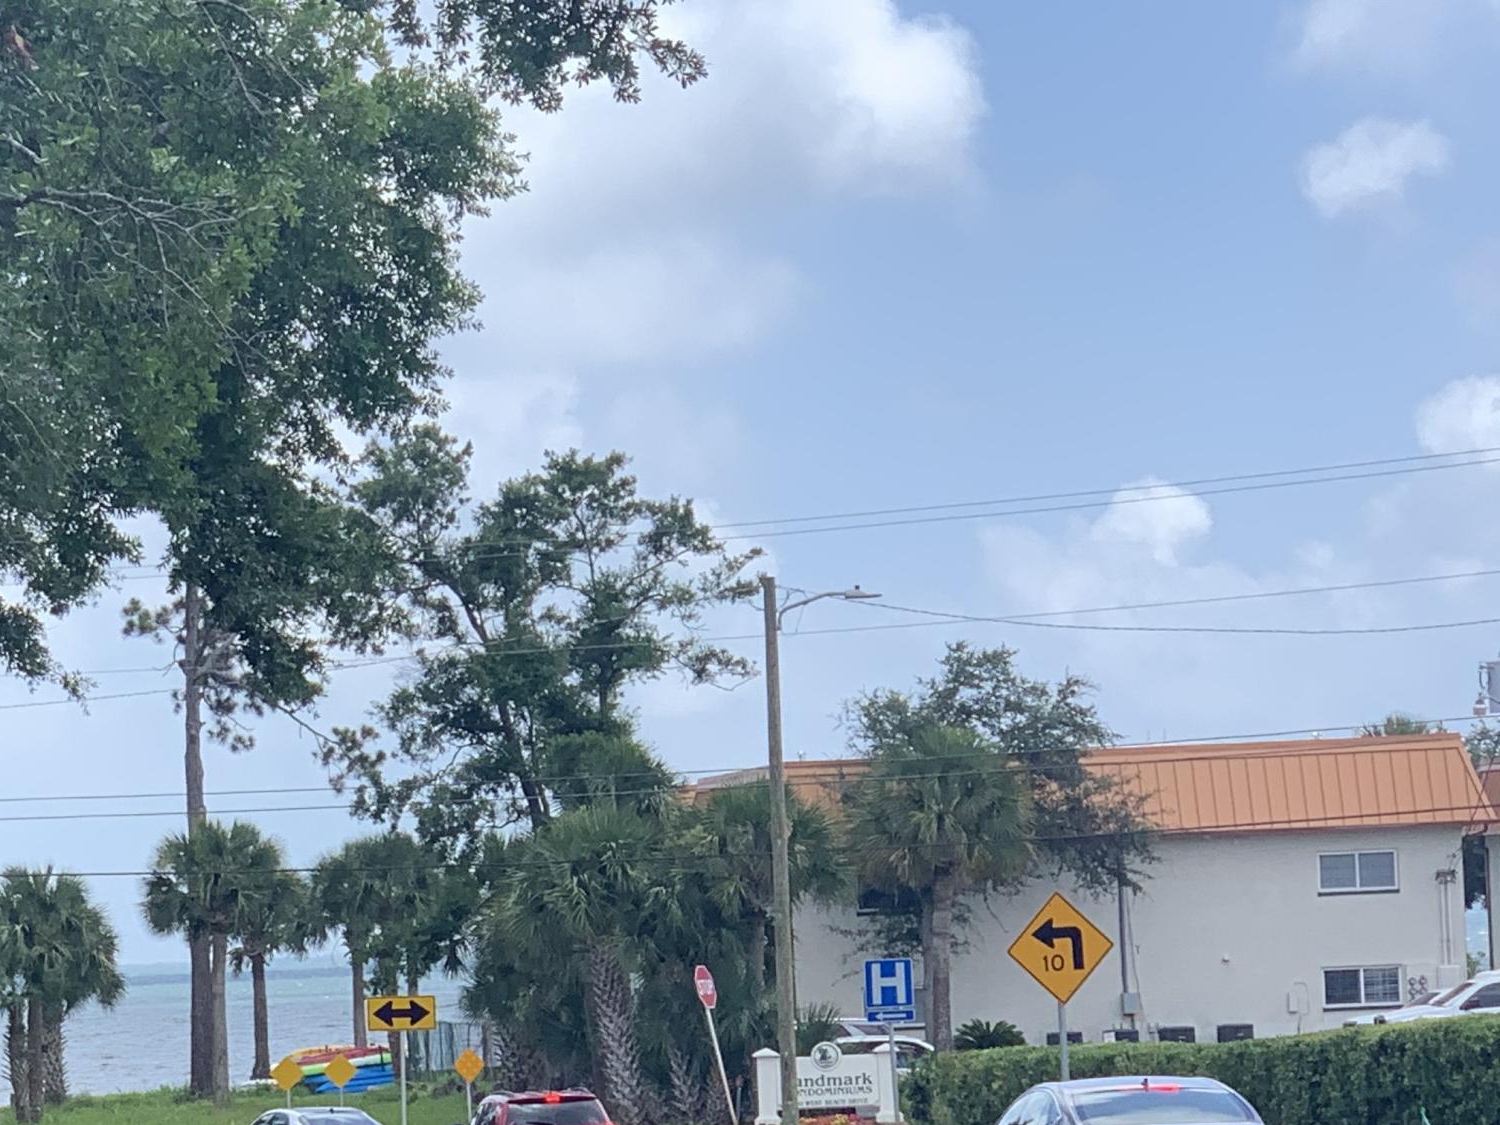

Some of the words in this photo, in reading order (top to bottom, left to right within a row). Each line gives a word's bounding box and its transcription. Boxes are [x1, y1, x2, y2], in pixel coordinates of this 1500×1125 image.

[1043, 954, 1065, 973] 10
[871, 962, 907, 1005] H
[797, 1072, 873, 1087] andmark
[799, 1085, 873, 1097] NDOMINIUMS
